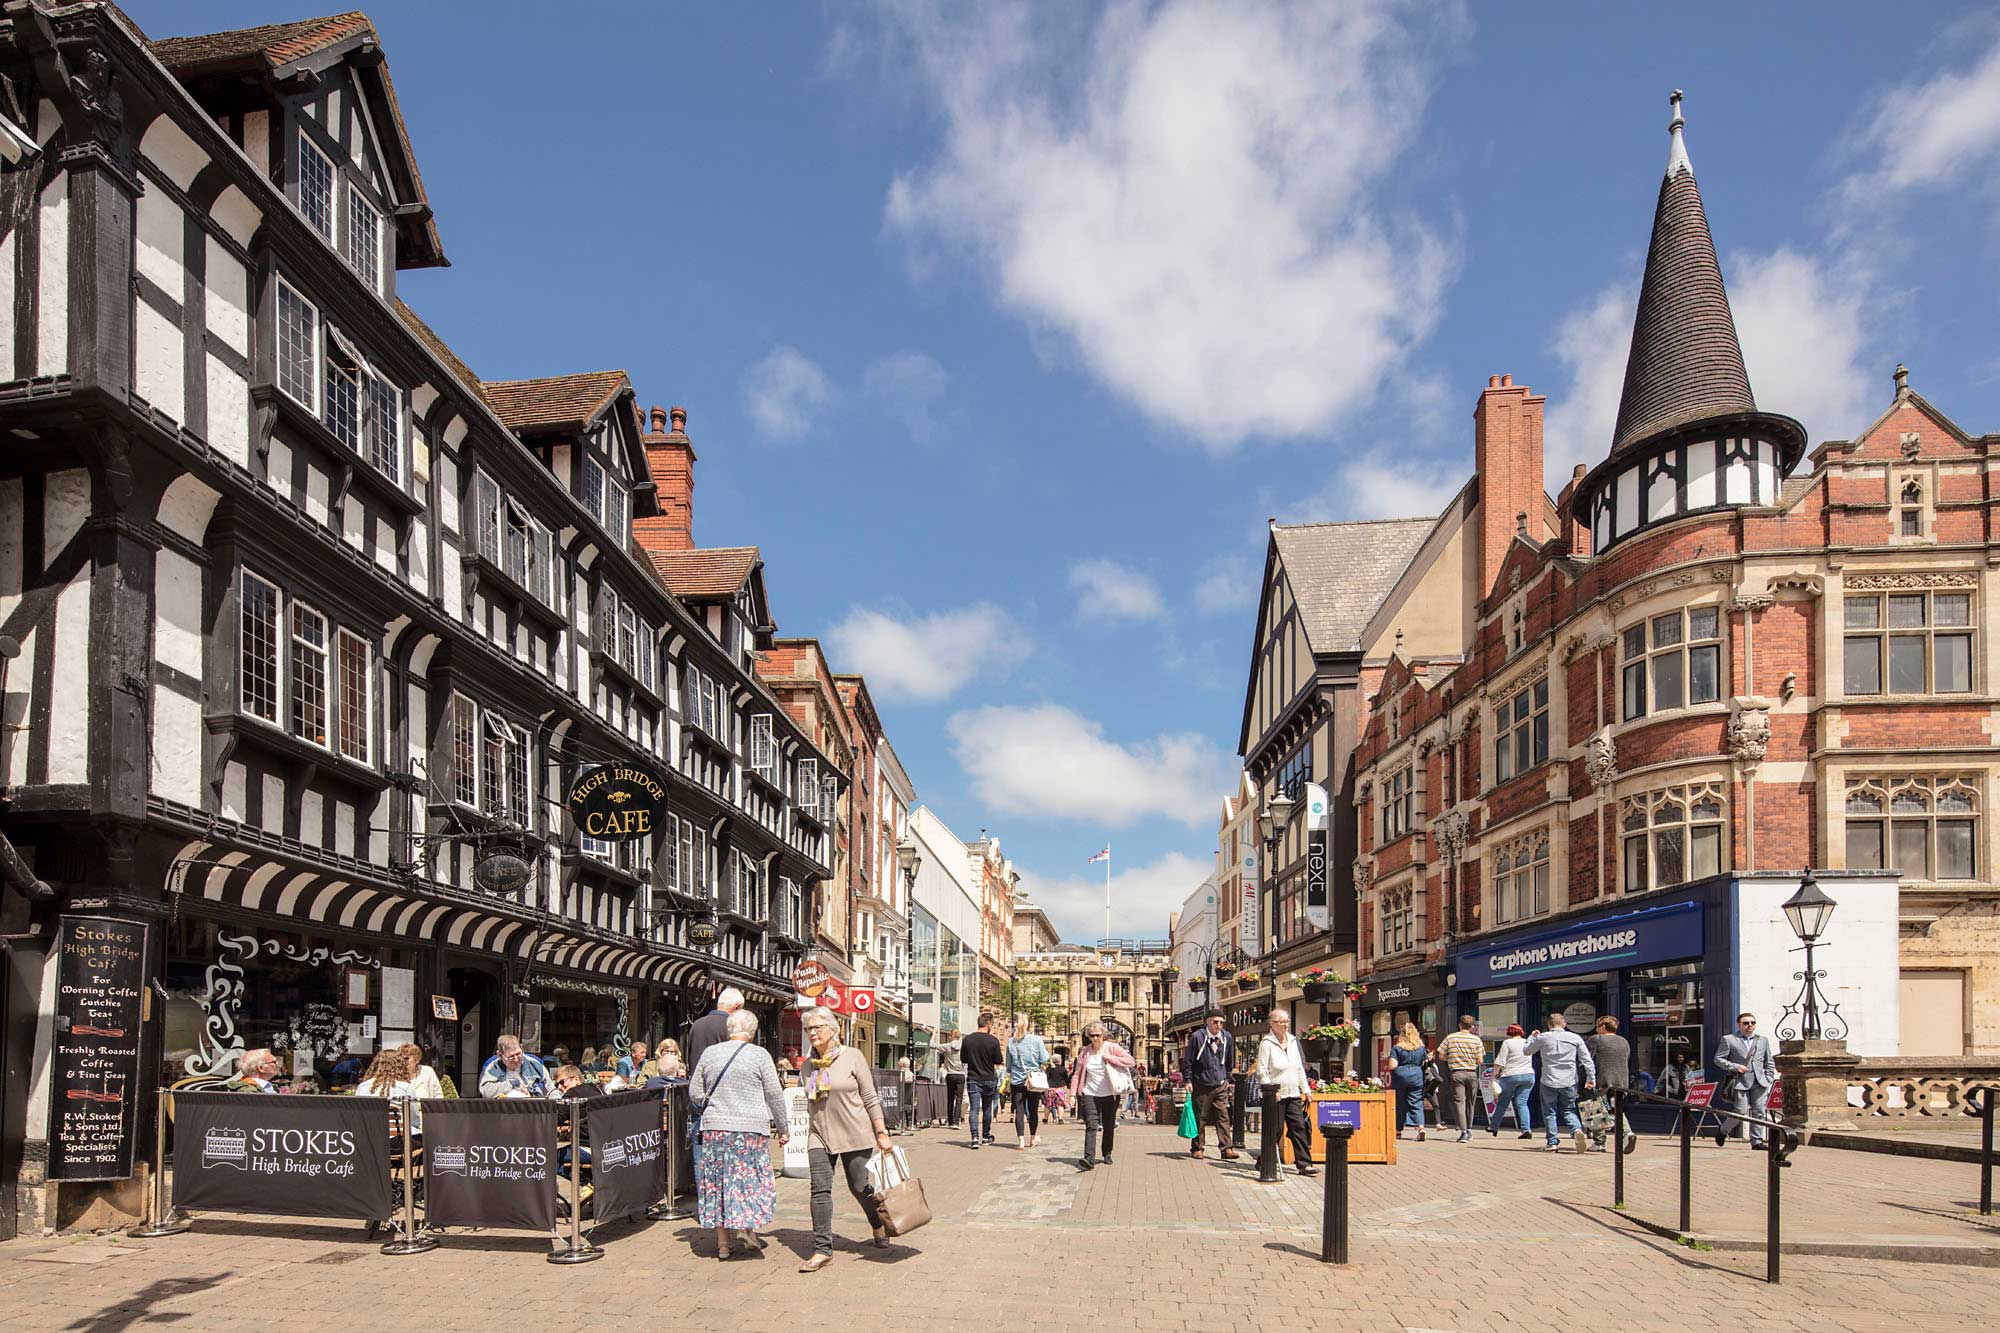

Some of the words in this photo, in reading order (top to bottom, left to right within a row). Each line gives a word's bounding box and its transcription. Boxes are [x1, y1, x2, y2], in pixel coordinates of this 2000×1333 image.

[573, 771, 608, 804] HIGH
[614, 768, 664, 800] BRIDGE
[586, 809, 651, 835] CAFE
[1309, 843, 1325, 892] next
[75, 926, 132, 943] Stokes
[691, 929, 715, 938] CAFE
[64, 943, 95, 957] High
[100, 945, 140, 960] Bridge
[1489, 946, 1549, 970] Carphone
[1548, 929, 1637, 960] Warehouse
[794, 966, 817, 978] Pasty
[92, 975, 111, 984] For
[797, 973, 829, 988] Republic
[61, 985, 105, 997] Morning
[108, 987, 138, 997] Coffee
[80, 998, 121, 1007] Lunches
[88, 1009, 113, 1018] Teas
[59, 1046, 95, 1056] Freshly
[98, 1046, 136, 1056] Roasted
[80, 1059, 114, 1068] Coffee
[66, 1070, 75, 1079] &
[78, 1071, 100, 1079] Fine
[104, 1071, 126, 1079] Teas
[75, 1123, 99, 1131] Sons
[788, 1117, 808, 1126] STO
[91, 1133, 122, 1141] Coffee
[794, 1128, 808, 1136] cof
[252, 1128, 355, 1156] STOKES
[625, 1128, 661, 1153] STOKE
[65, 1143, 117, 1152] Specialists
[64, 1155, 91, 1163] Since
[470, 1145, 547, 1166] STOKES
[252, 1156, 280, 1174] High
[284, 1158, 321, 1176] Bridge
[325, 1159, 354, 1178] Café
[470, 1166, 491, 1179] High
[494, 1167, 521, 1180] Bridge
[525, 1167, 546, 1181] Café
